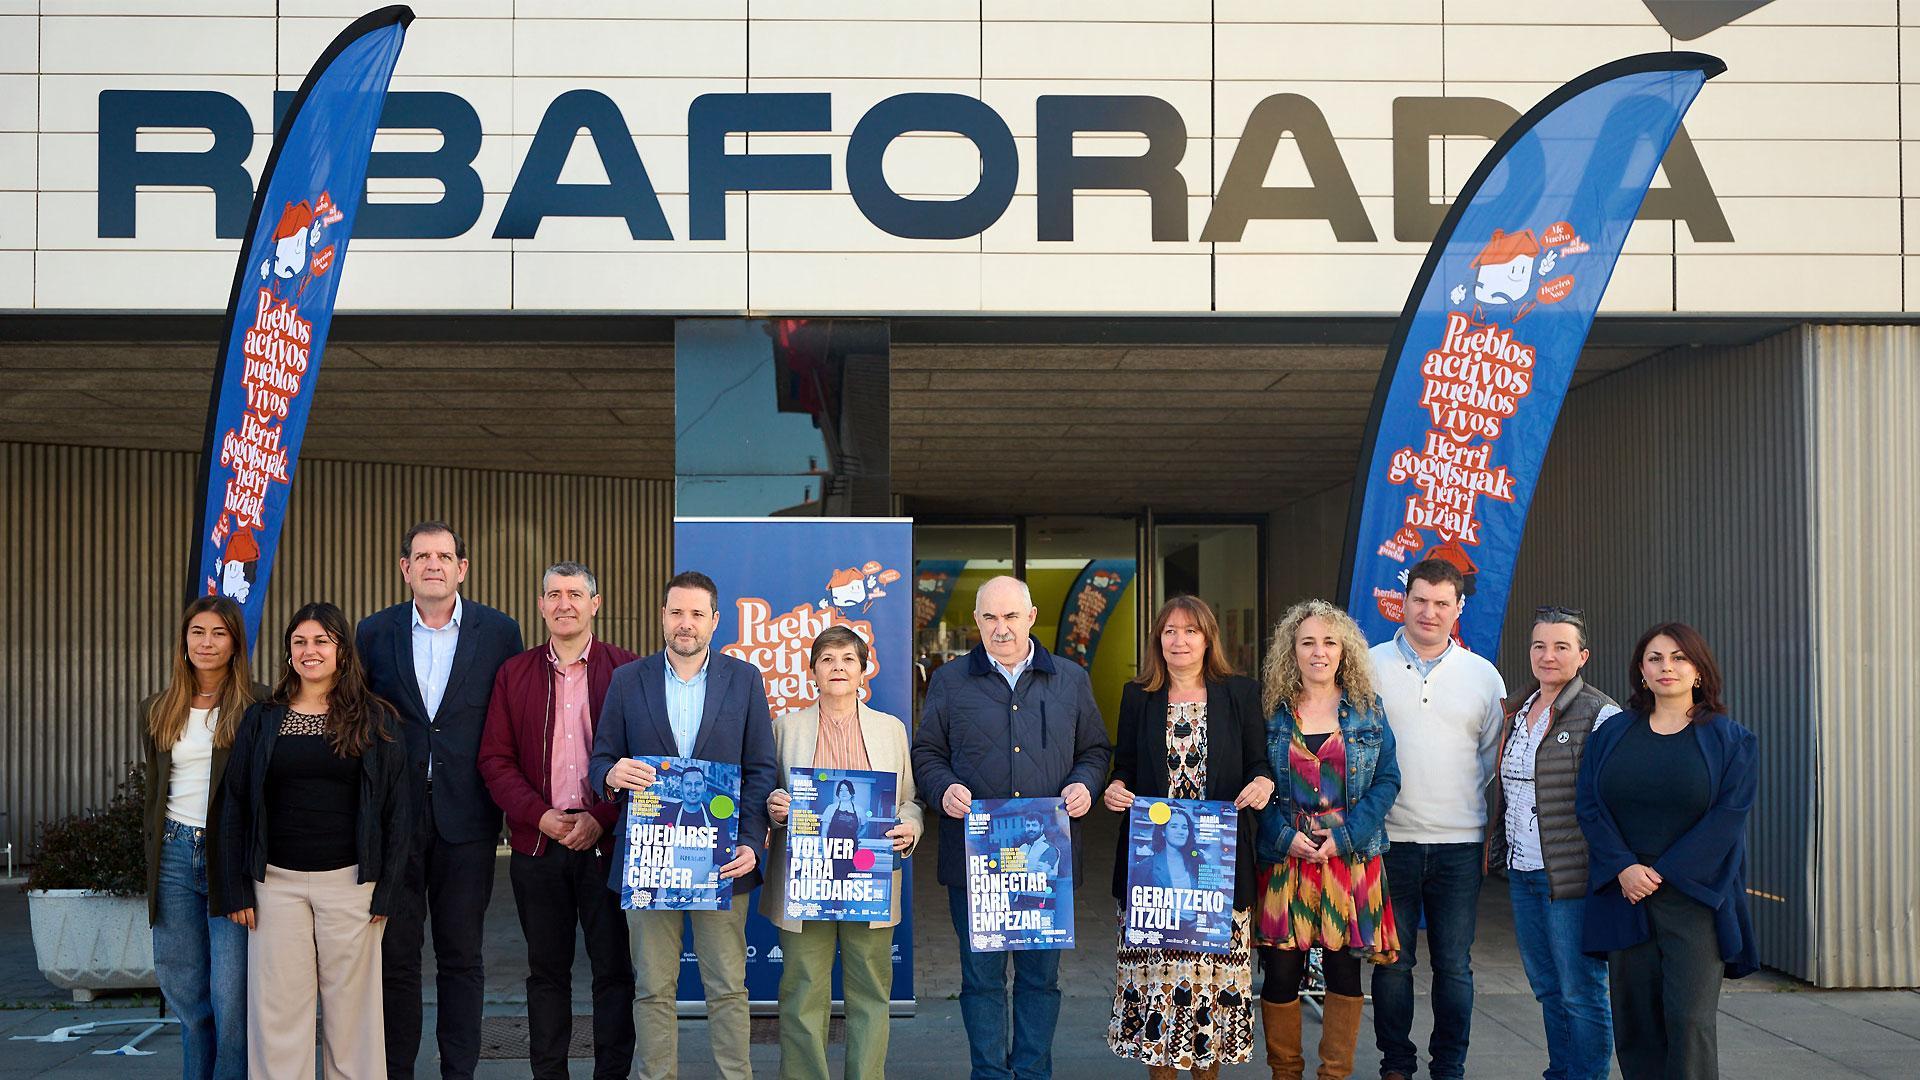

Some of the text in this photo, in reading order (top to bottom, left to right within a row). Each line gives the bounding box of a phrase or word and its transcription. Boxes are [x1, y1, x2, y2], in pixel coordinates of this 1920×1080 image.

[255, 291, 310, 344] Pueblos
[245, 329, 309, 372] activos
[1442, 315, 1533, 368] Pueblos
[243, 358, 299, 394] pueblos
[1423, 351, 1529, 394] activos
[1422, 379, 1515, 414] pueblos
[240, 415, 281, 452] Herri
[221, 431, 288, 481] gogotsuak
[1425, 433, 1489, 470] Herri
[236, 466, 270, 497] herri
[1389, 450, 1513, 499] gogotsuak
[225, 482, 263, 527] biziak
[1424, 478, 1475, 514] herri
[1406, 498, 1478, 543] biziak
[741, 602, 870, 647] Puebls
[630, 823, 719, 849] QUEDARSE
[791, 837, 854, 860] VOLVER
[629, 845, 674, 867] PARA
[790, 857, 834, 880] PARA
[969, 855, 988, 875] RE
[627, 866, 693, 888] CRECER
[789, 879, 873, 902] QUEDARSE
[970, 872, 1047, 893] CONECTAR
[971, 892, 1010, 913] PARA
[1131, 886, 1224, 913] GERATZEKO
[972, 910, 1041, 932] EMPEZAR
[1130, 906, 1180, 931] ITZULI
